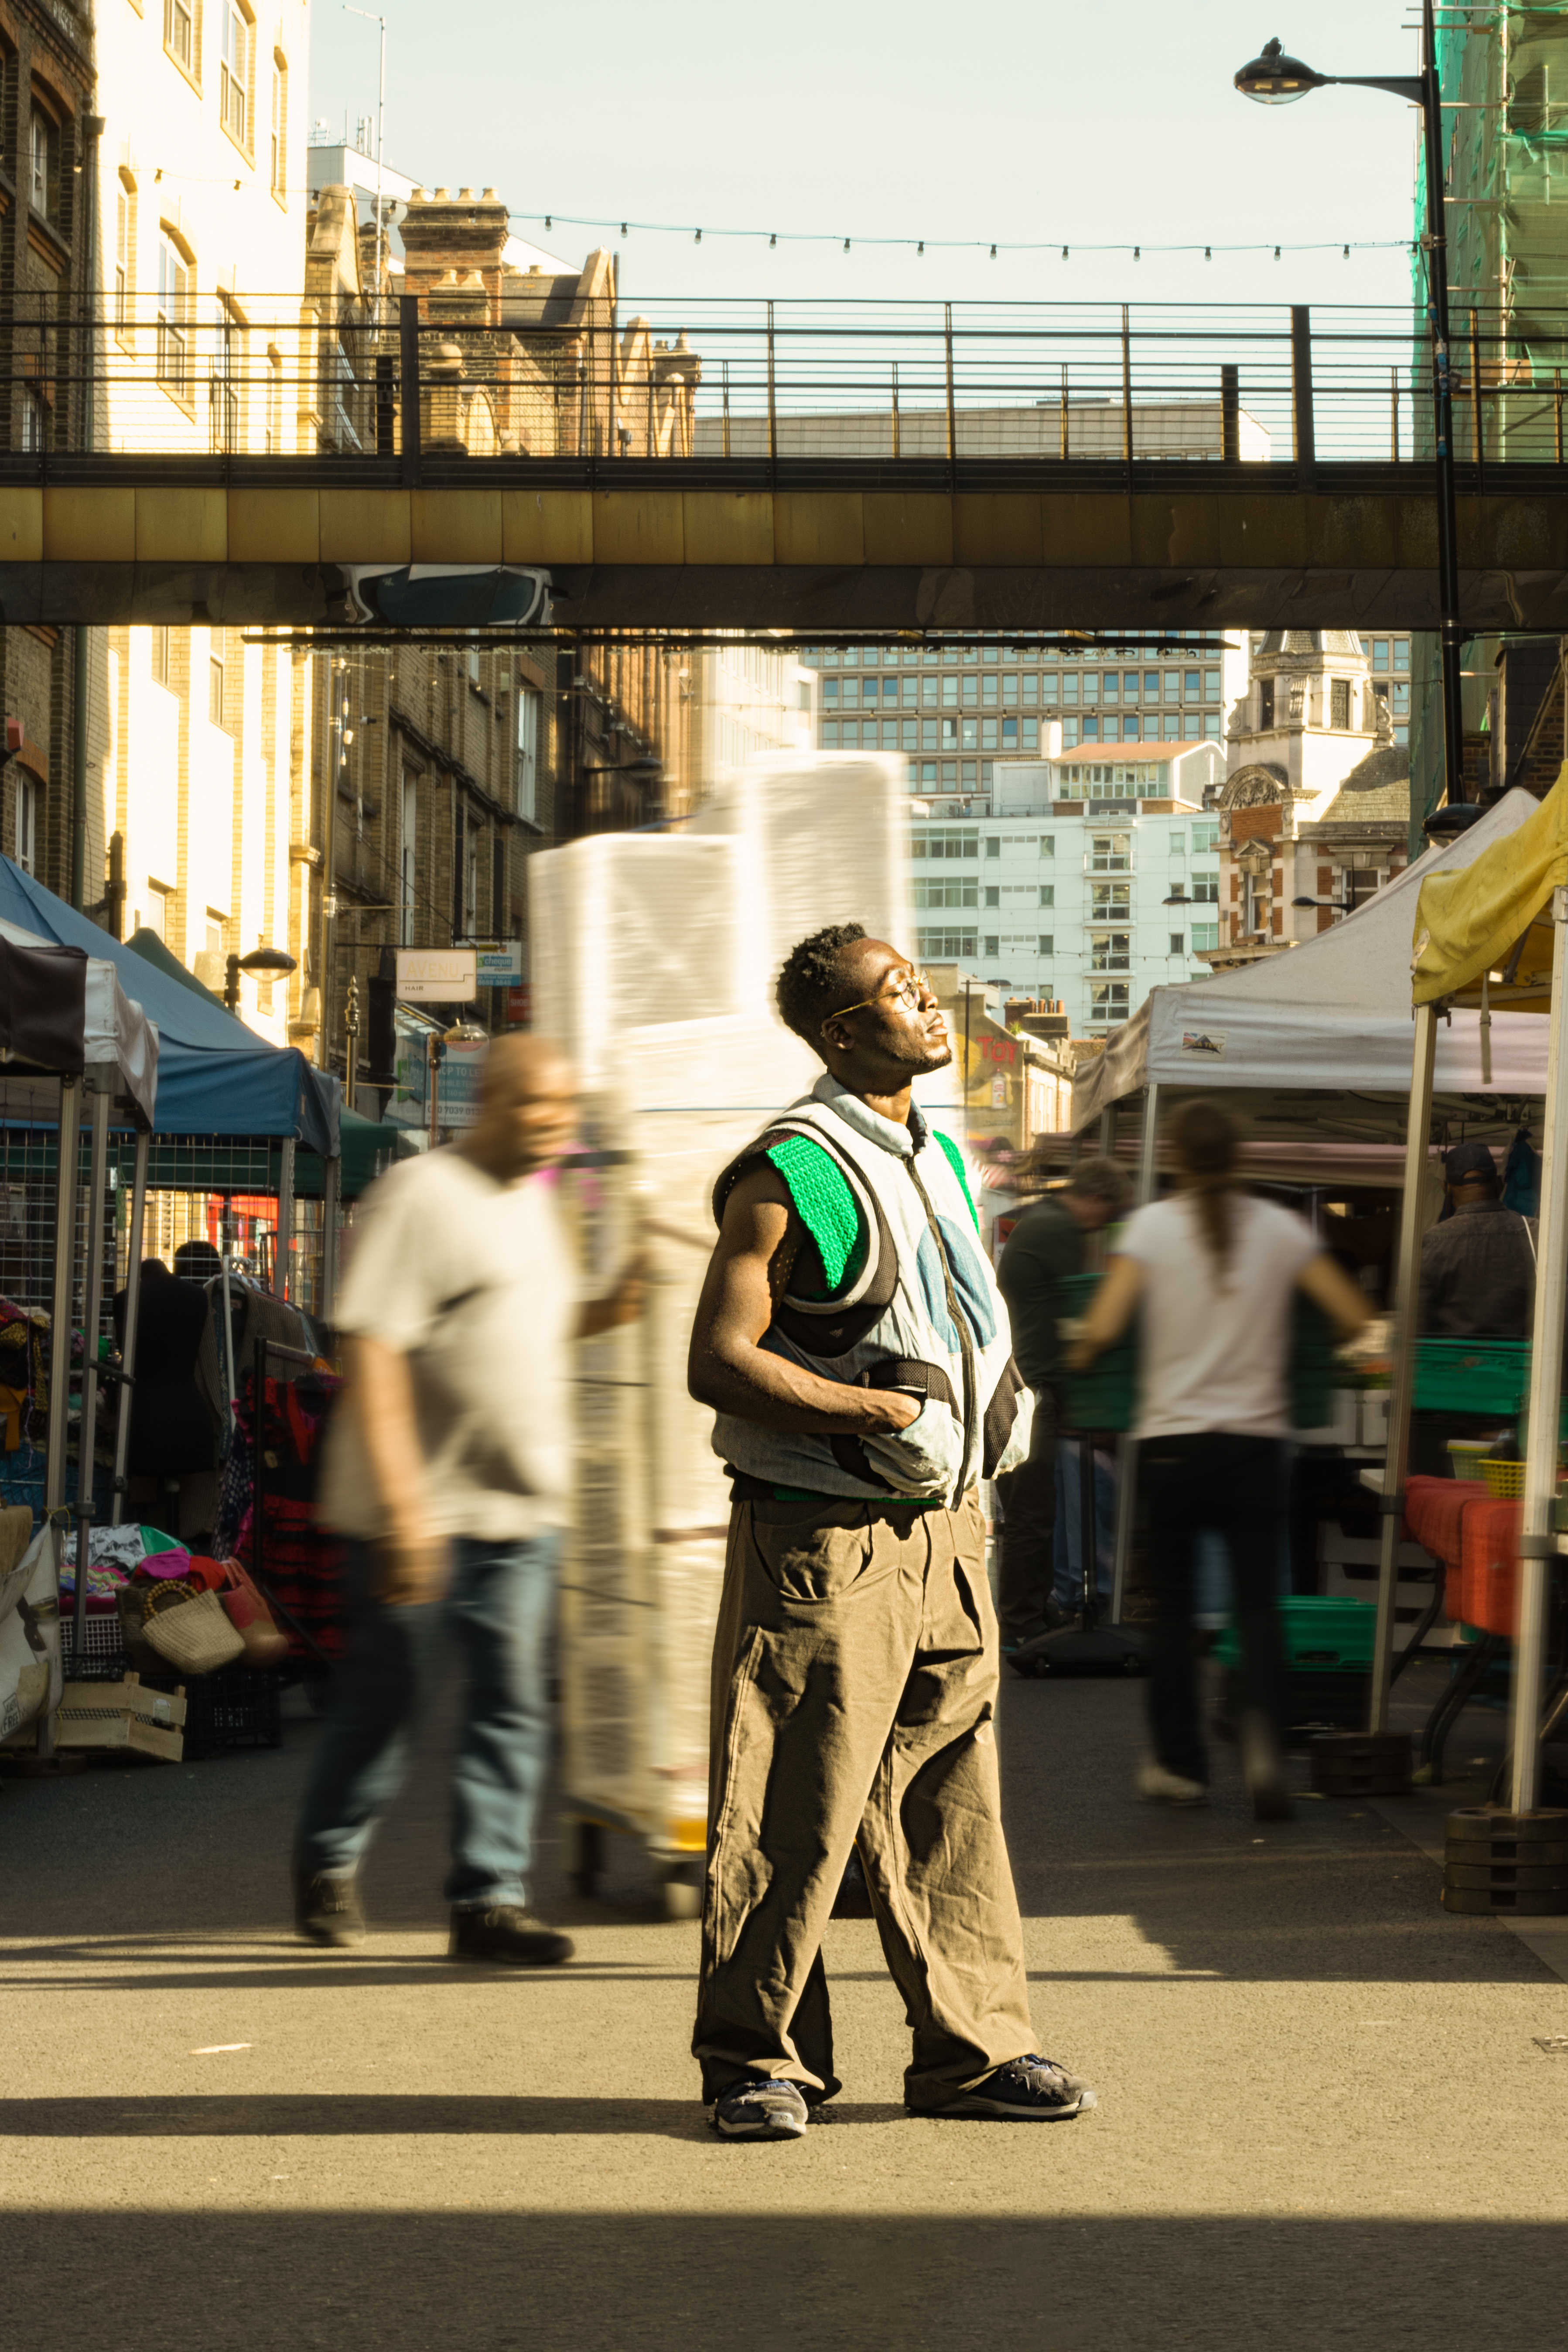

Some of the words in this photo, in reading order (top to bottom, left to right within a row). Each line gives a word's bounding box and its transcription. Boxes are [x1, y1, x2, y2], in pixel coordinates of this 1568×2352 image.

[485, 955, 511, 967] cheque
[406, 960, 458, 978] AVENU
[510, 998, 528, 1007] SHOE
[976, 1036, 1018, 1065] TOY
[456, 1067, 467, 1077] TO
[428, 1105, 442, 1114] 00
[444, 1106, 464, 1115] 7039
[3, 1711, 18, 1731] FREE
